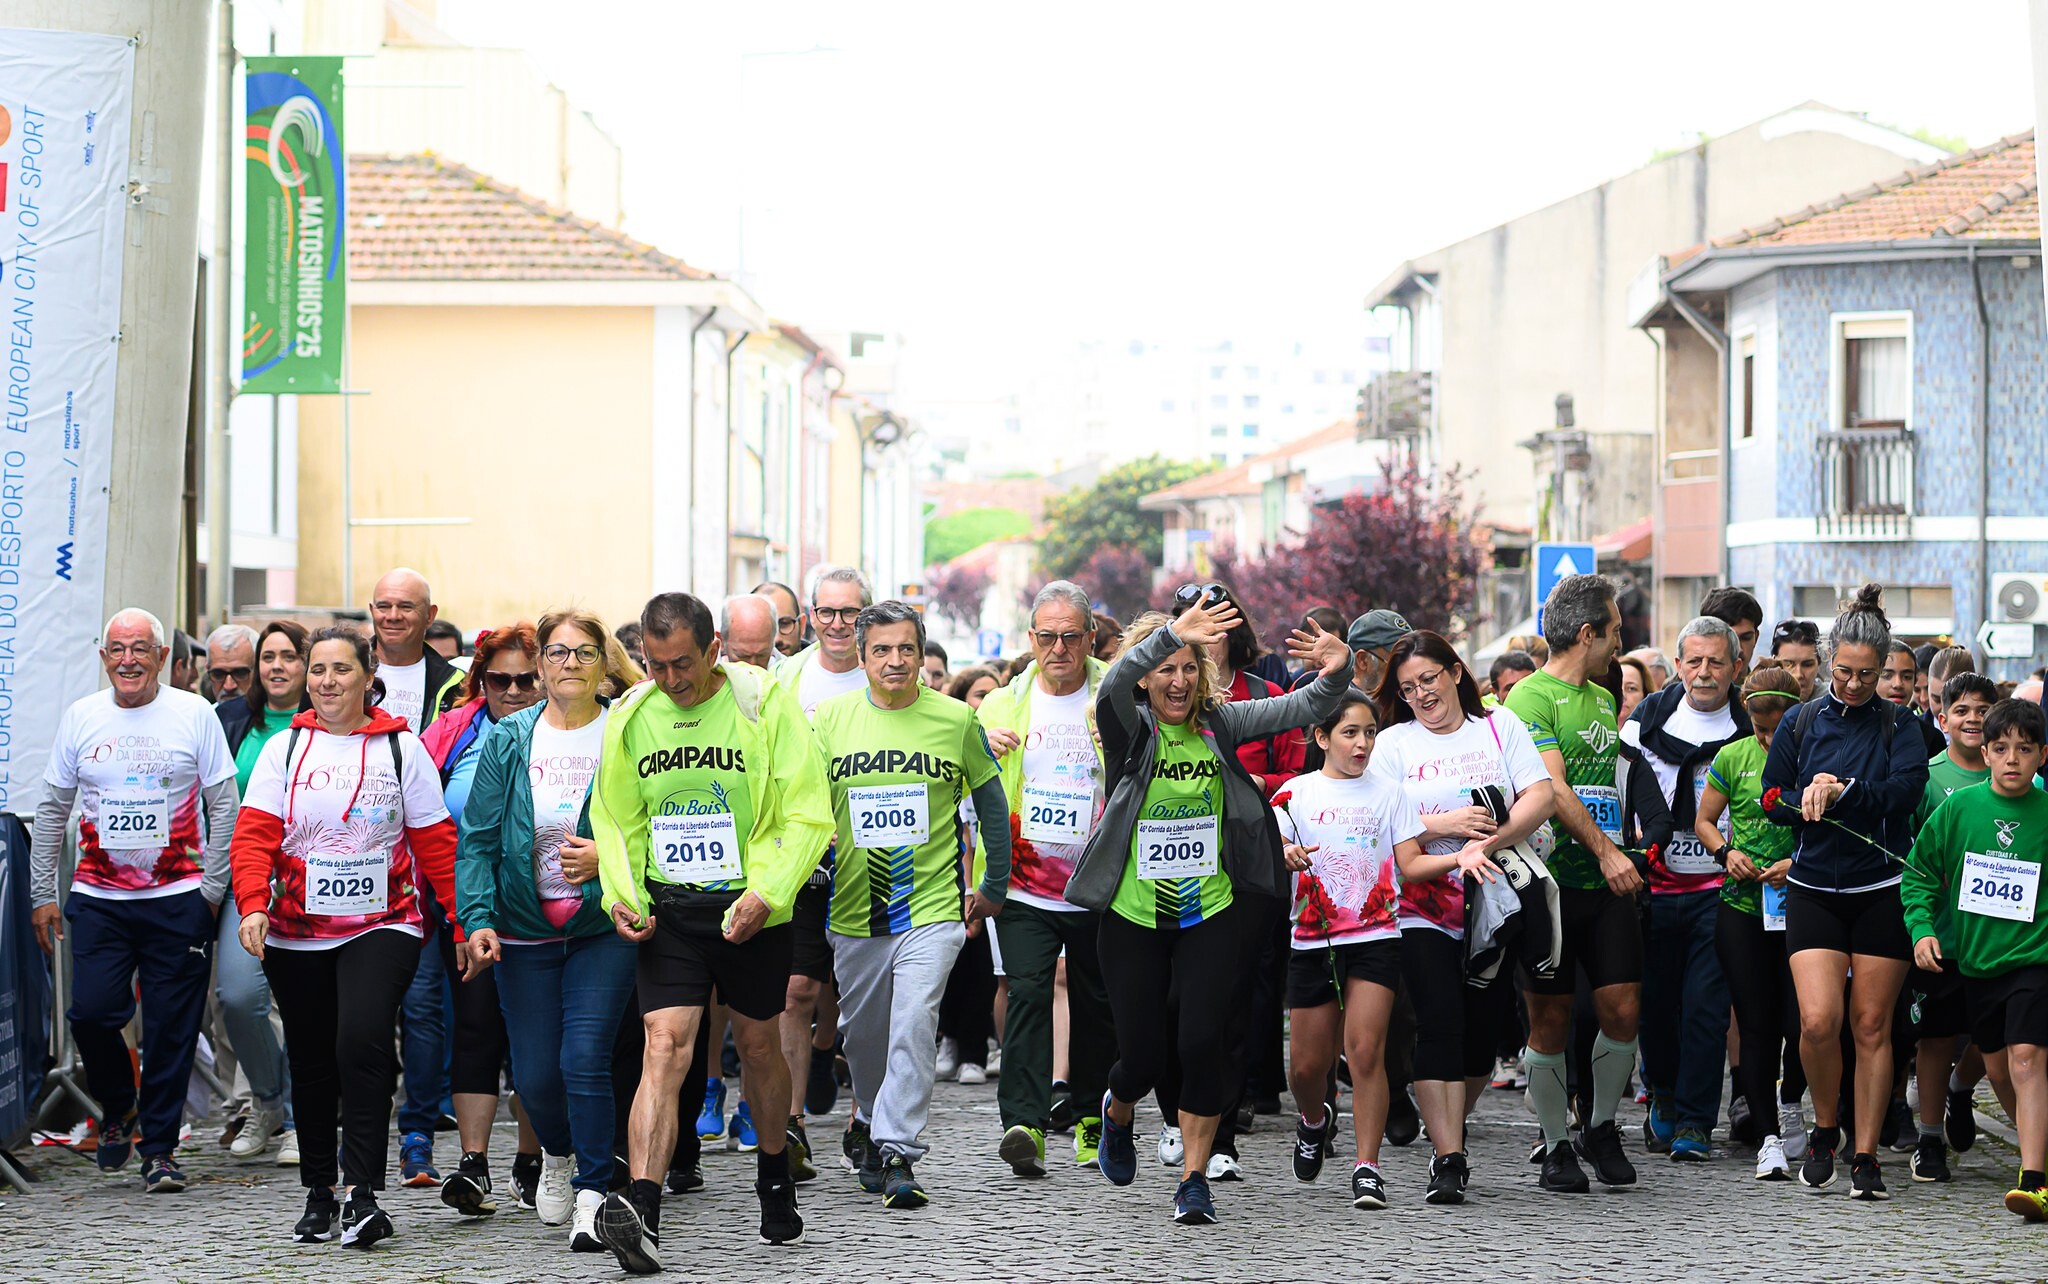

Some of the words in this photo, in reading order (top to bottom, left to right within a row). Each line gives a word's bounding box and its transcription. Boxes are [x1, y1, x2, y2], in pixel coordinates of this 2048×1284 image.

[20, 104, 46, 189] SPORT
[18, 192, 40, 228] OF
[14, 232, 38, 291] CITY
[6, 297, 34, 434] EUROPEAN
[63, 390, 74, 450] matosinhos
[72, 422, 81, 450] sport
[67, 476, 78, 537] matosinhos
[0, 450, 26, 585] DESPORTO
[0, 594, 19, 630] DO
[118, 736, 161, 748] CORRIDA
[116, 749, 130, 762] DA
[638, 746, 747, 779] CARAPAUS
[830, 750, 954, 783] CARAPAUS
[336, 778, 352, 790] DA
[549, 773, 564, 786] DA
[882, 791, 904, 799] Liberdade
[686, 799, 722, 816] Bois
[1030, 806, 1077, 827] 2021
[1151, 804, 1174, 818] Du
[1175, 804, 1208, 819] Bois
[108, 814, 157, 831] 2202
[661, 822, 679, 831] Corrida
[686, 821, 710, 830] Liberdade
[861, 808, 916, 829] 2008
[1147, 825, 1165, 833] Corrida
[1173, 823, 1195, 832] Liberdade
[665, 841, 724, 863] 2019
[1148, 841, 1205, 862] 2009
[316, 858, 333, 867] Corrida
[341, 859, 364, 868] Liberdade
[1973, 859, 1989, 868] Corrida
[1995, 862, 2017, 873] Liberdade
[316, 877, 374, 897] 2029
[1970, 877, 2024, 902] 2048
